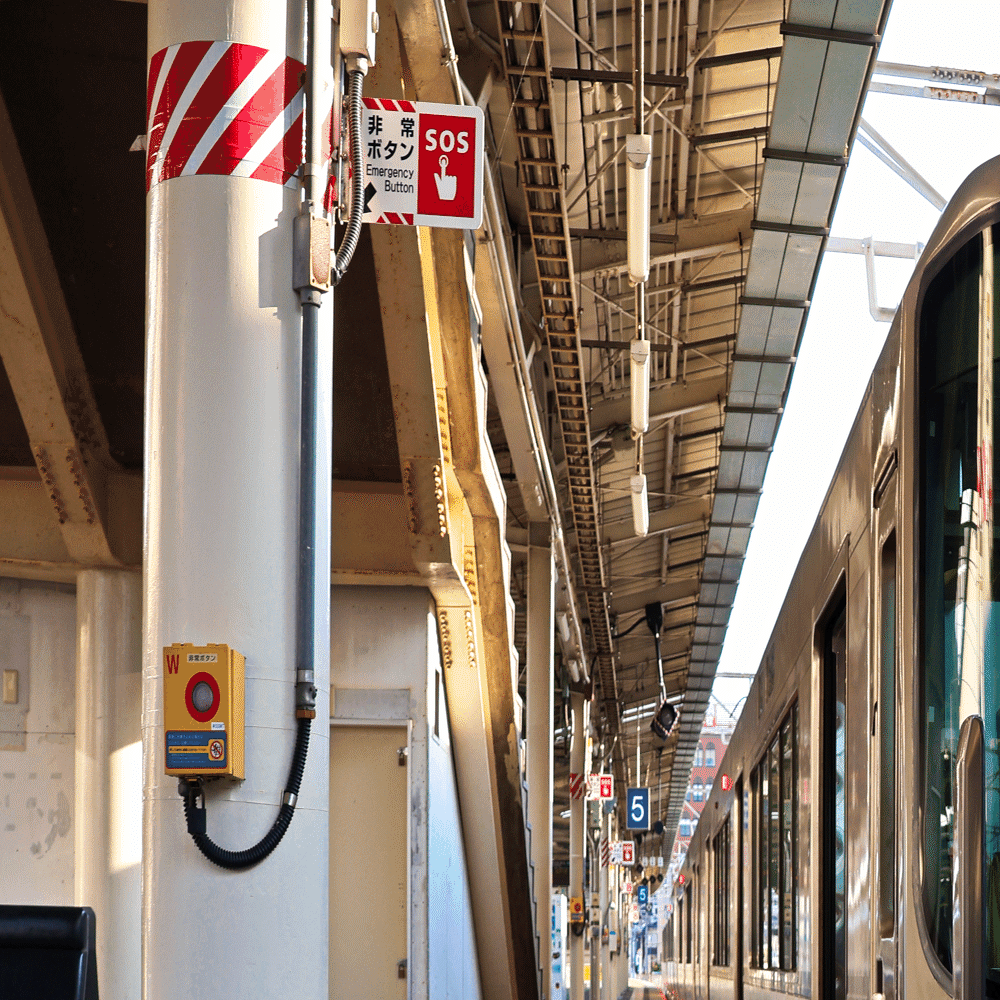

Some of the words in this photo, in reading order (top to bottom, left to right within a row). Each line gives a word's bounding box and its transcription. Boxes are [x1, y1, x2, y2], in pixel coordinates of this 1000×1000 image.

[368, 115, 415, 137] 非常
[367, 138, 414, 160] ボタン
[425, 129, 469, 153] SOS
[366, 164, 414, 179] Emergency
[384, 180, 414, 193] Button
[166, 654, 180, 674] W
[631, 796, 645, 822] 5
[640, 888, 646, 901] 5
